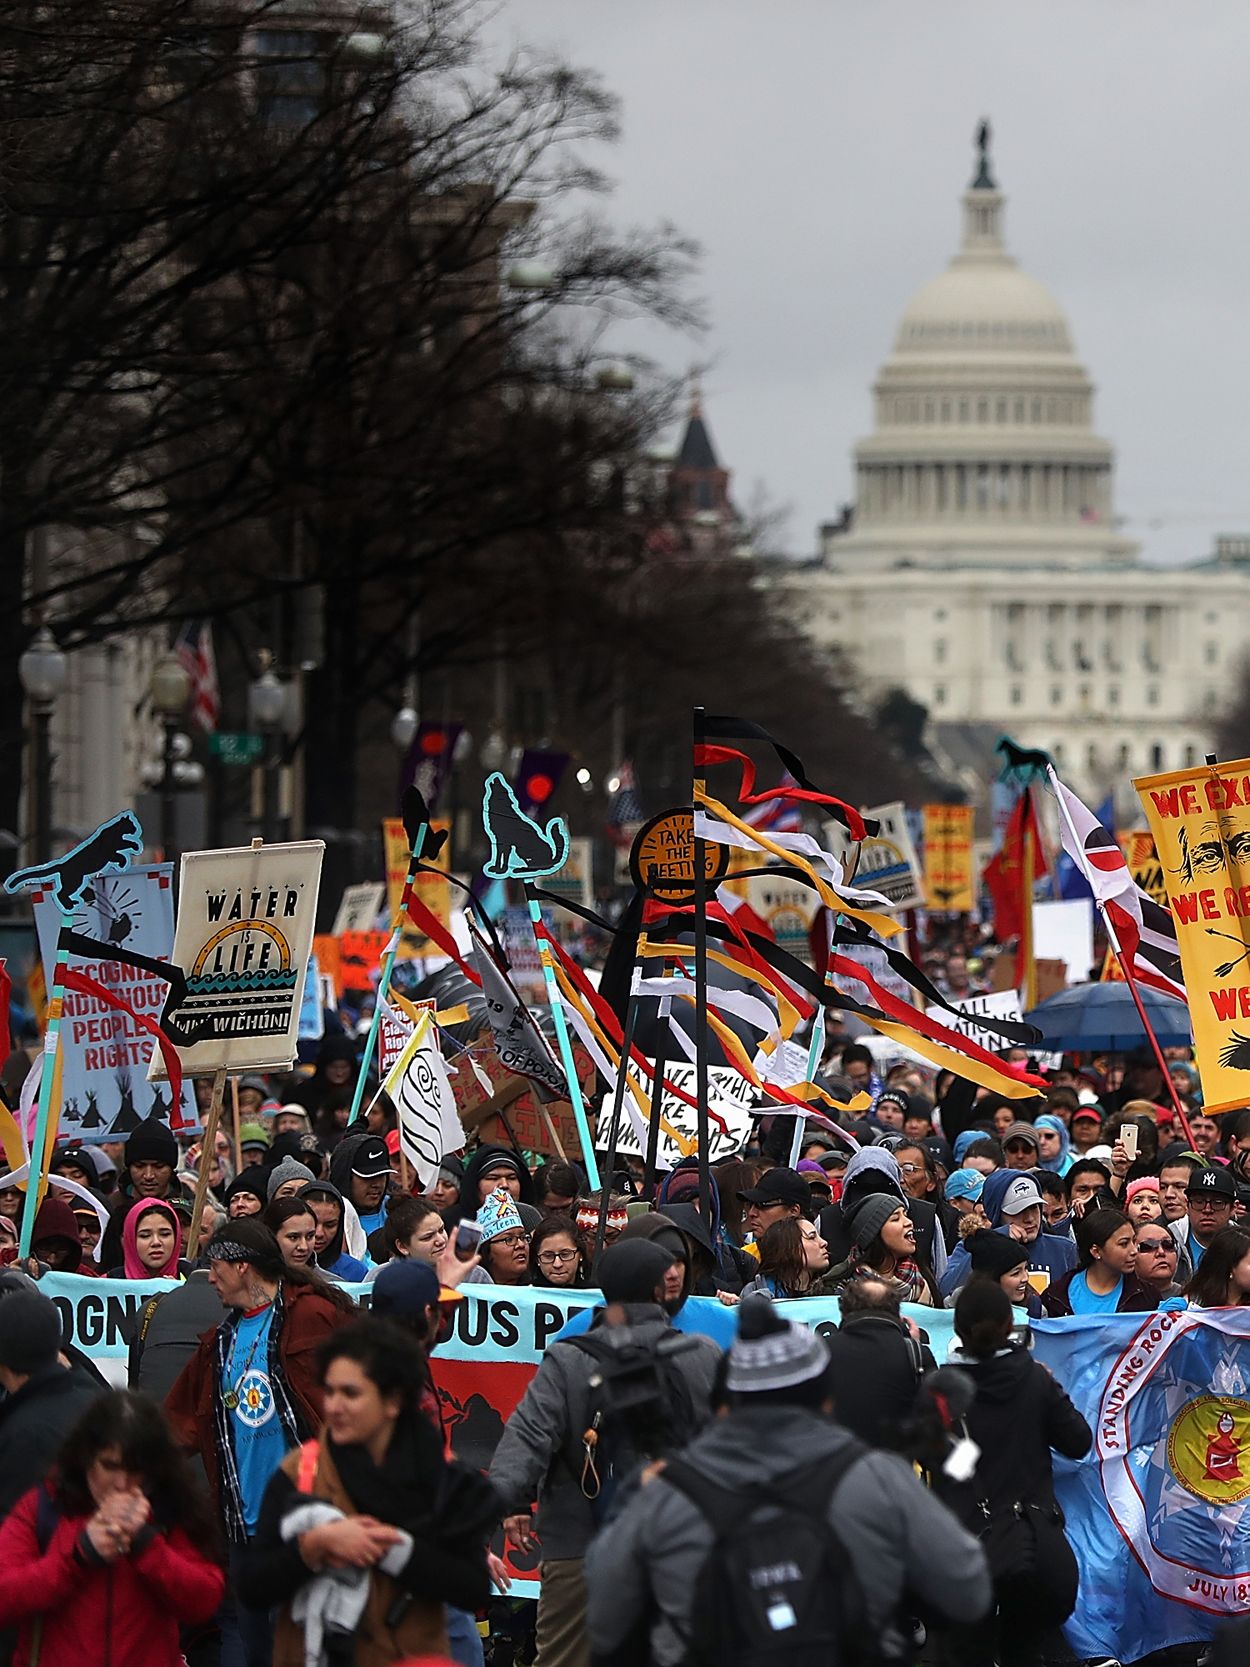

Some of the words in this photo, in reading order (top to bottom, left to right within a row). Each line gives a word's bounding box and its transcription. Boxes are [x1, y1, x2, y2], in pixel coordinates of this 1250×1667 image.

[1150, 784, 1202, 819] WE
[658, 828, 694, 845] TAKE
[665, 846, 691, 859] THE
[207, 890, 298, 922] WATER
[1172, 888, 1221, 925] WE
[240, 931, 251, 943] IS
[213, 943, 272, 972] LIFE
[488, 998, 504, 1013] 19
[959, 999, 989, 1015] ALL
[84, 1041, 153, 1071] RIGHTS
[502, 1050, 525, 1068] OF
[1103, 1356, 1144, 1449] STANDING
[1188, 1578, 1228, 1602] JULY
